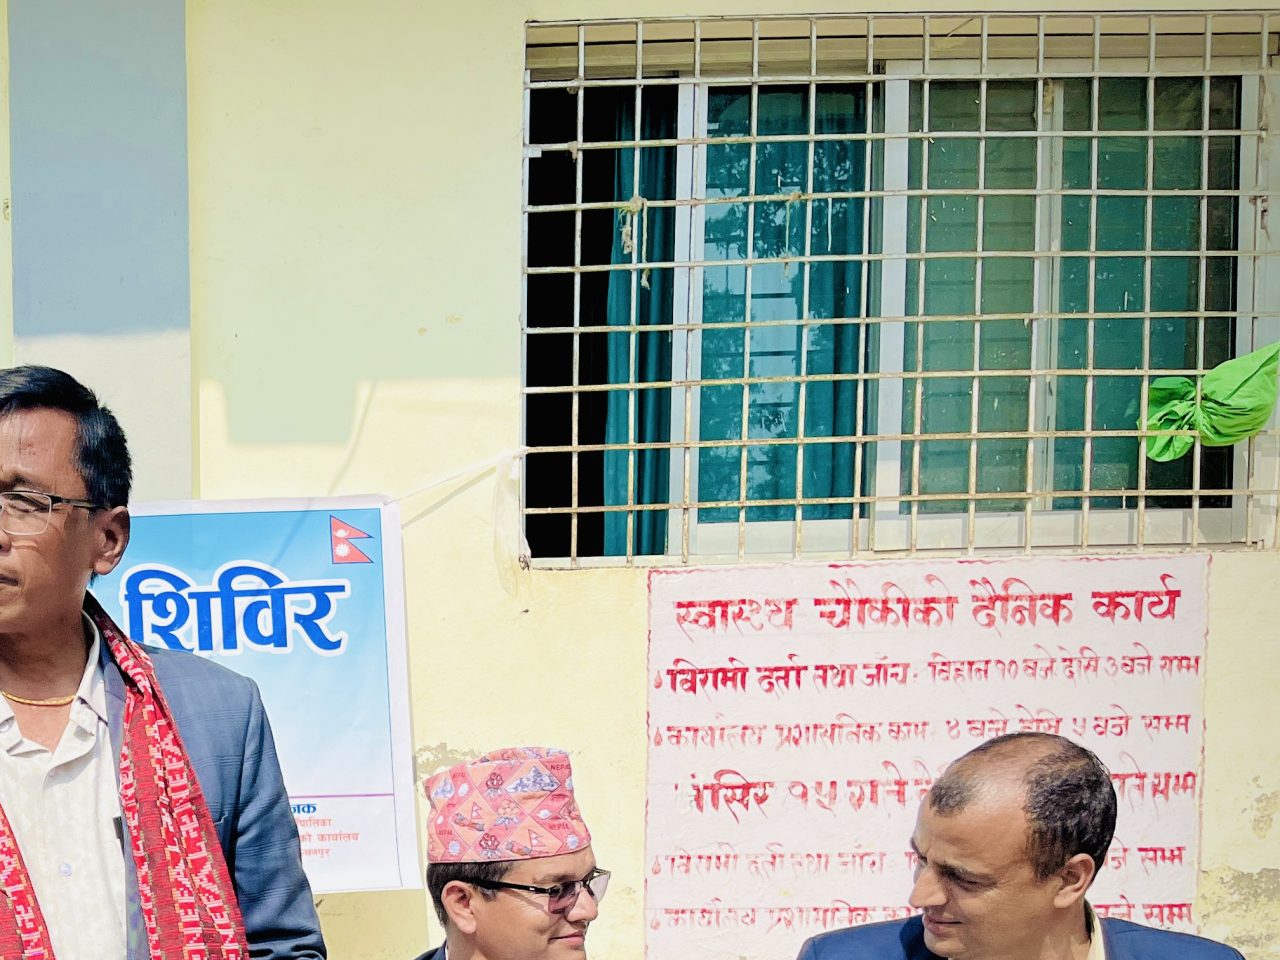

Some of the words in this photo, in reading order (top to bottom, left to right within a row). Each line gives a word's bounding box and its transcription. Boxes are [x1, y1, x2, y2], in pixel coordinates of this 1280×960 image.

[125, 566, 345, 652] शिविर
[970, 577, 1073, 637] दैनिक
[1091, 573, 1181, 624] कार्य
[1140, 714, 1192, 742] सम्म
[318, 830, 360, 843] कार्यालय
